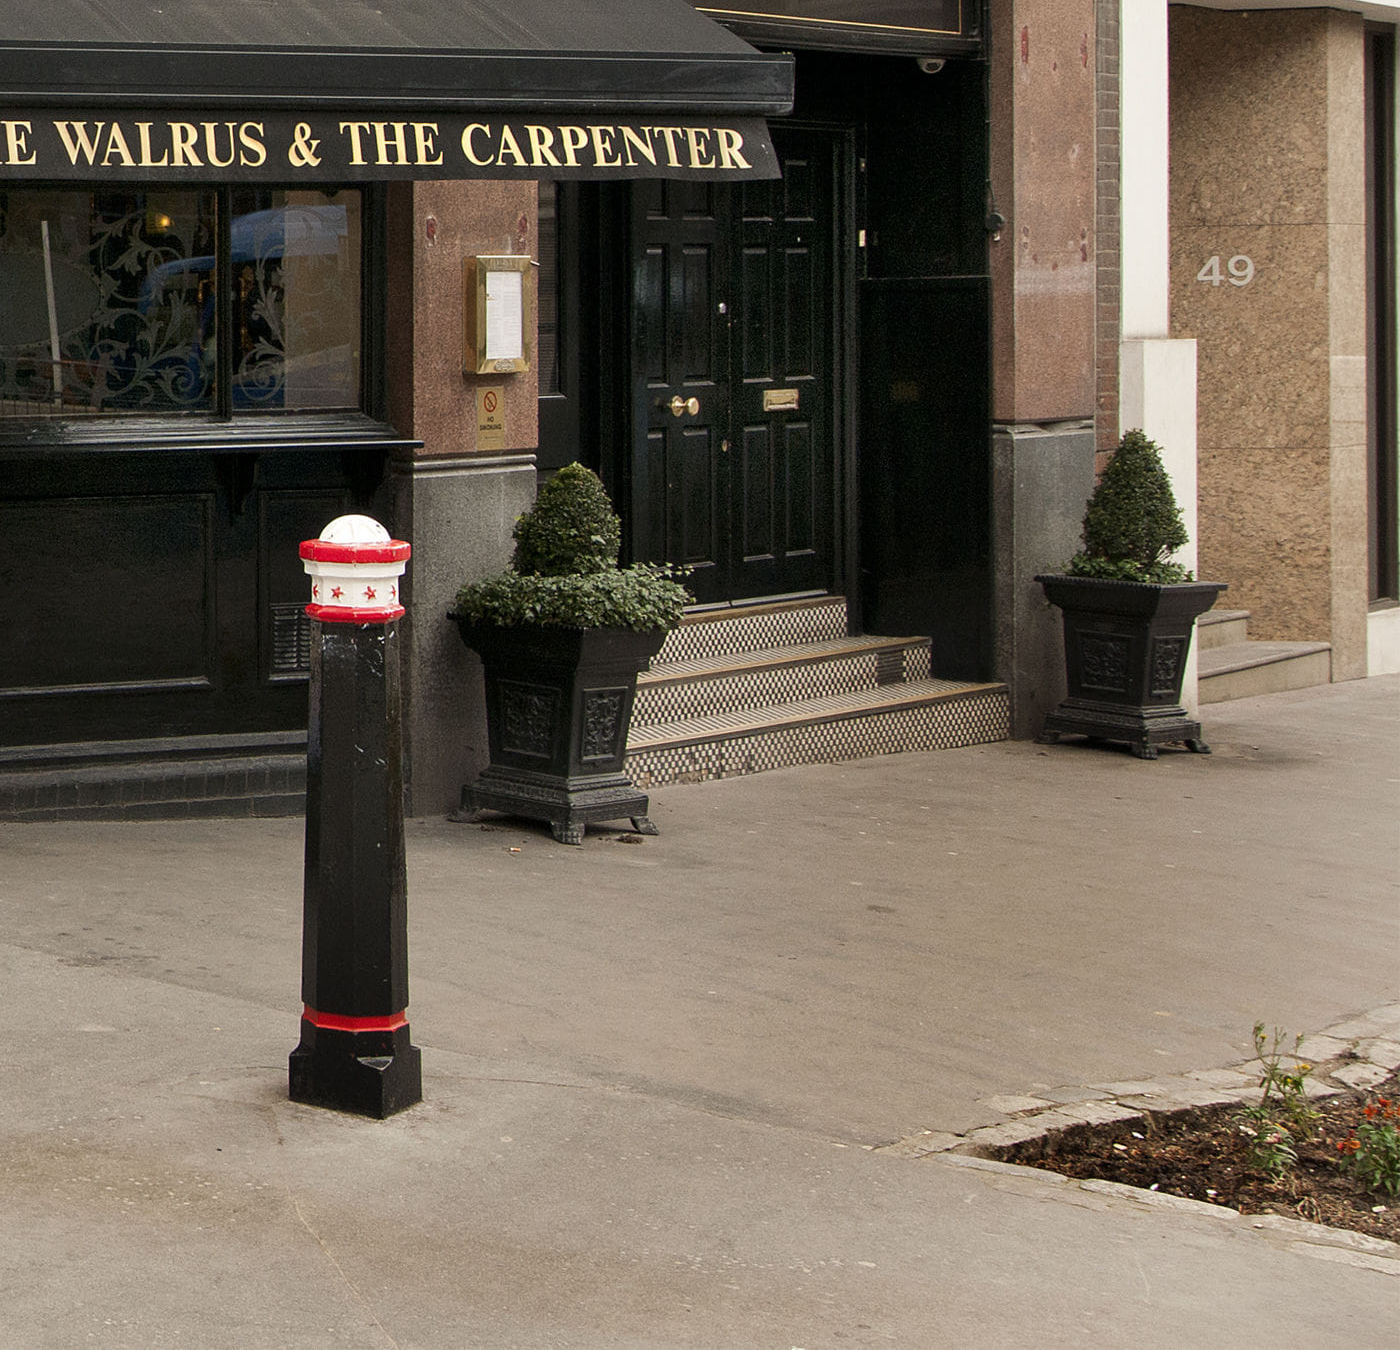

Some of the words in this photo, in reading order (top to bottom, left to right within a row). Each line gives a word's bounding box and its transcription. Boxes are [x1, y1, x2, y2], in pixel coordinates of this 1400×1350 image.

[53, 119, 268, 169] WALRUS
[288, 122, 322, 169] &
[340, 121, 444, 167] THE
[462, 122, 753, 171] CARPENTER
[1197, 255, 1255, 287] 49
